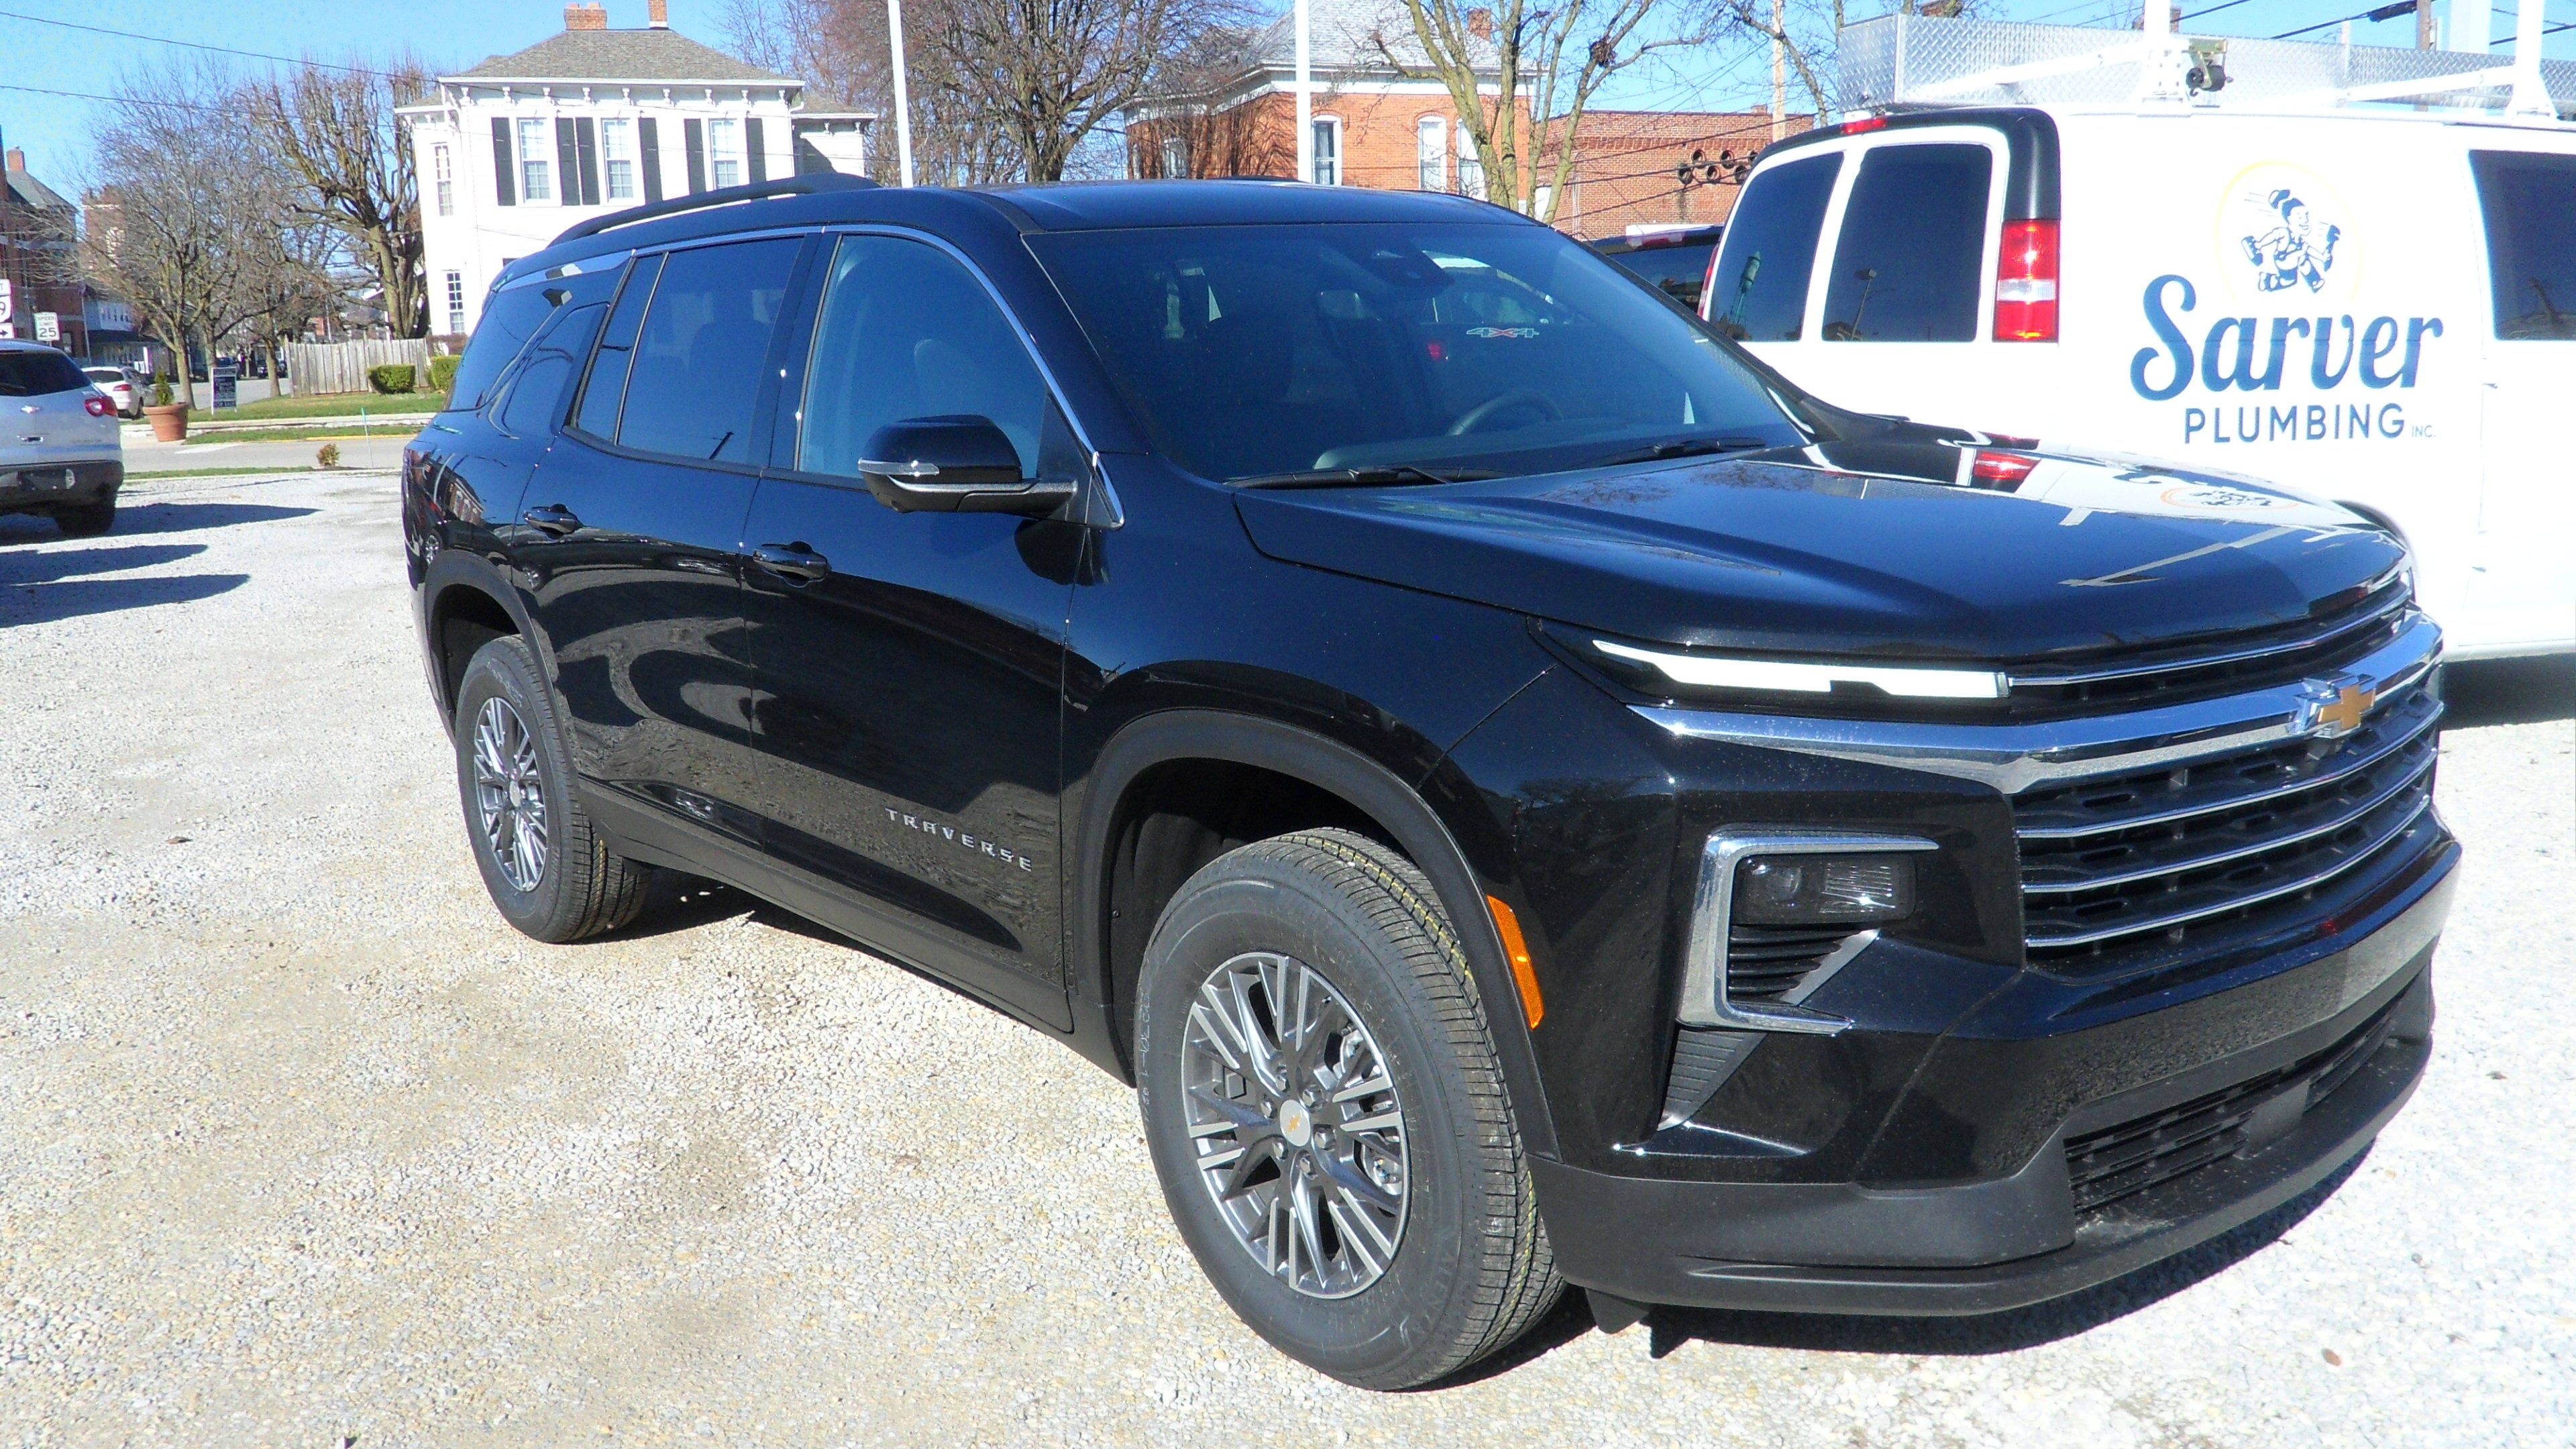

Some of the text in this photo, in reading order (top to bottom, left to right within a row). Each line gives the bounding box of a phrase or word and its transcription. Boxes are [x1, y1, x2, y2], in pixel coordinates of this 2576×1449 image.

[39, 327, 57, 337] 25
[2130, 274, 2444, 401] Sarver
[2184, 402, 2405, 444] PLUMBING
[885, 807, 1032, 872] TRAVERSE
